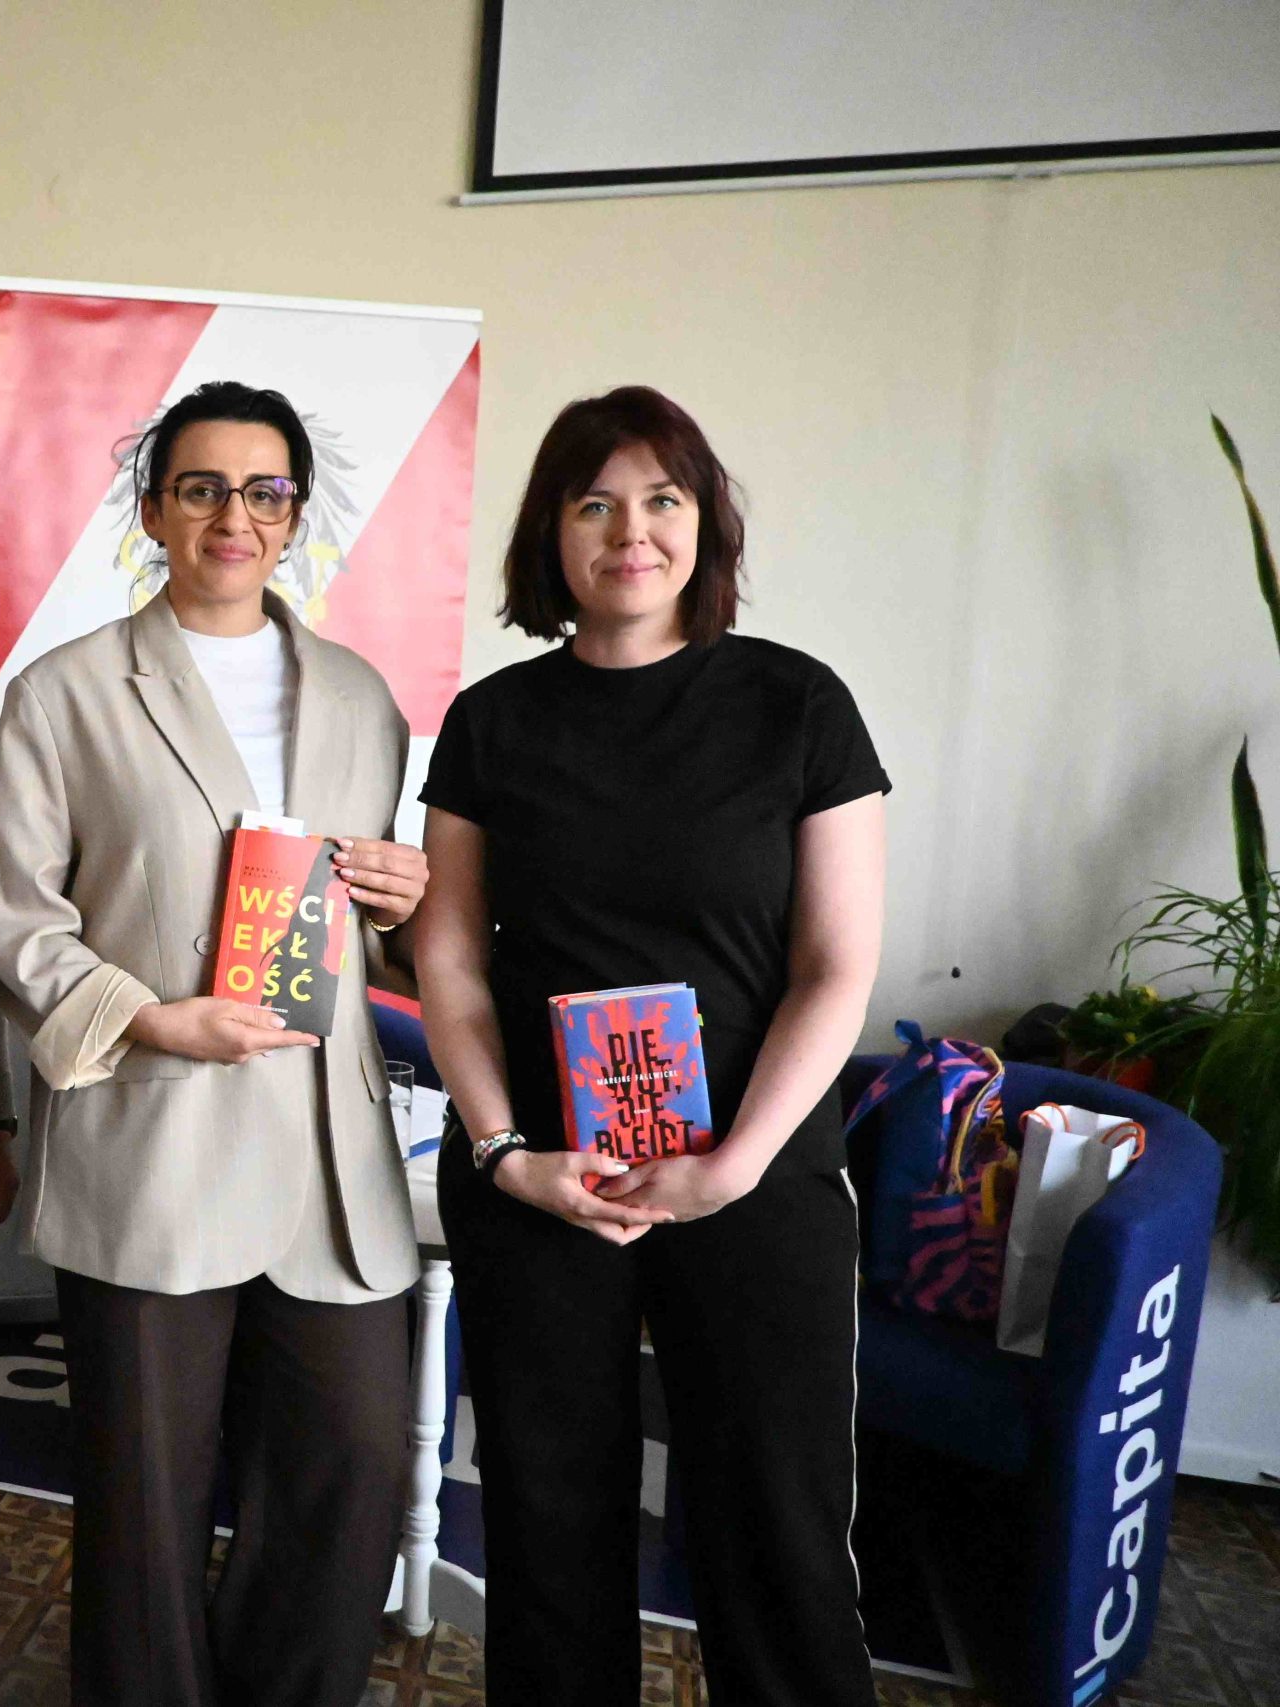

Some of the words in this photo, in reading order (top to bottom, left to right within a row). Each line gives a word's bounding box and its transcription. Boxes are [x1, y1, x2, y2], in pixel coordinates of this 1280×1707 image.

[239, 885, 335, 925] WŚCI
[232, 922, 309, 960] EKŁ
[226, 963, 315, 1002] OŚĆ
